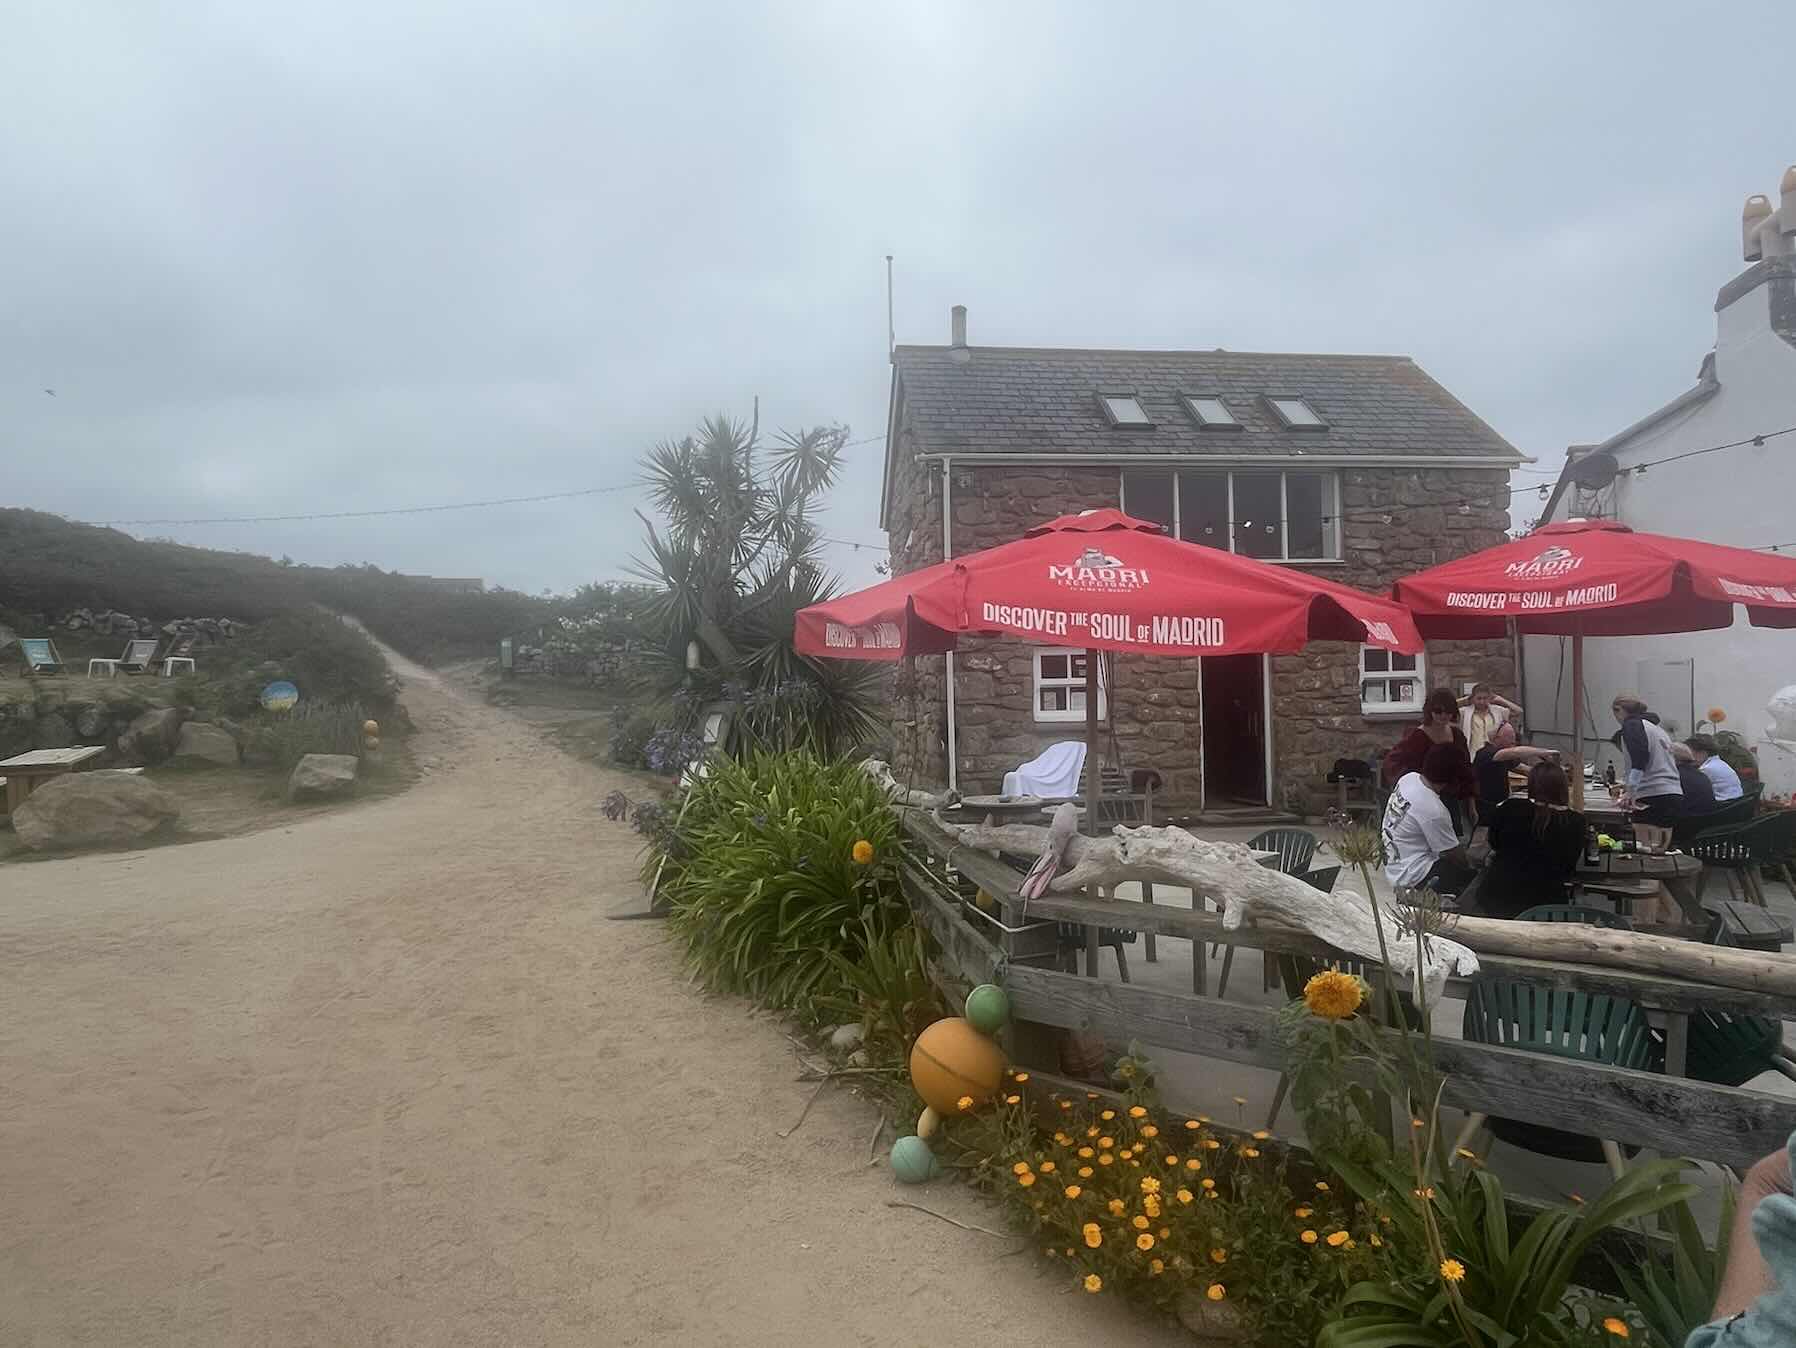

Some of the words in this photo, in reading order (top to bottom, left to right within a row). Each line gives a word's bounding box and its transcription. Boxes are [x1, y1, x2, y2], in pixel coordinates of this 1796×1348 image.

[1447, 592, 1506, 609] DISCOVER
[1521, 591, 1553, 609] SOUL
[1565, 583, 1617, 606] MADRID
[983, 602, 1068, 636] DISCOVER
[1070, 612, 1089, 626] THE
[1090, 612, 1136, 642] SOUL
[1137, 624, 1150, 643] OF
[1152, 615, 1224, 647] MADRID
